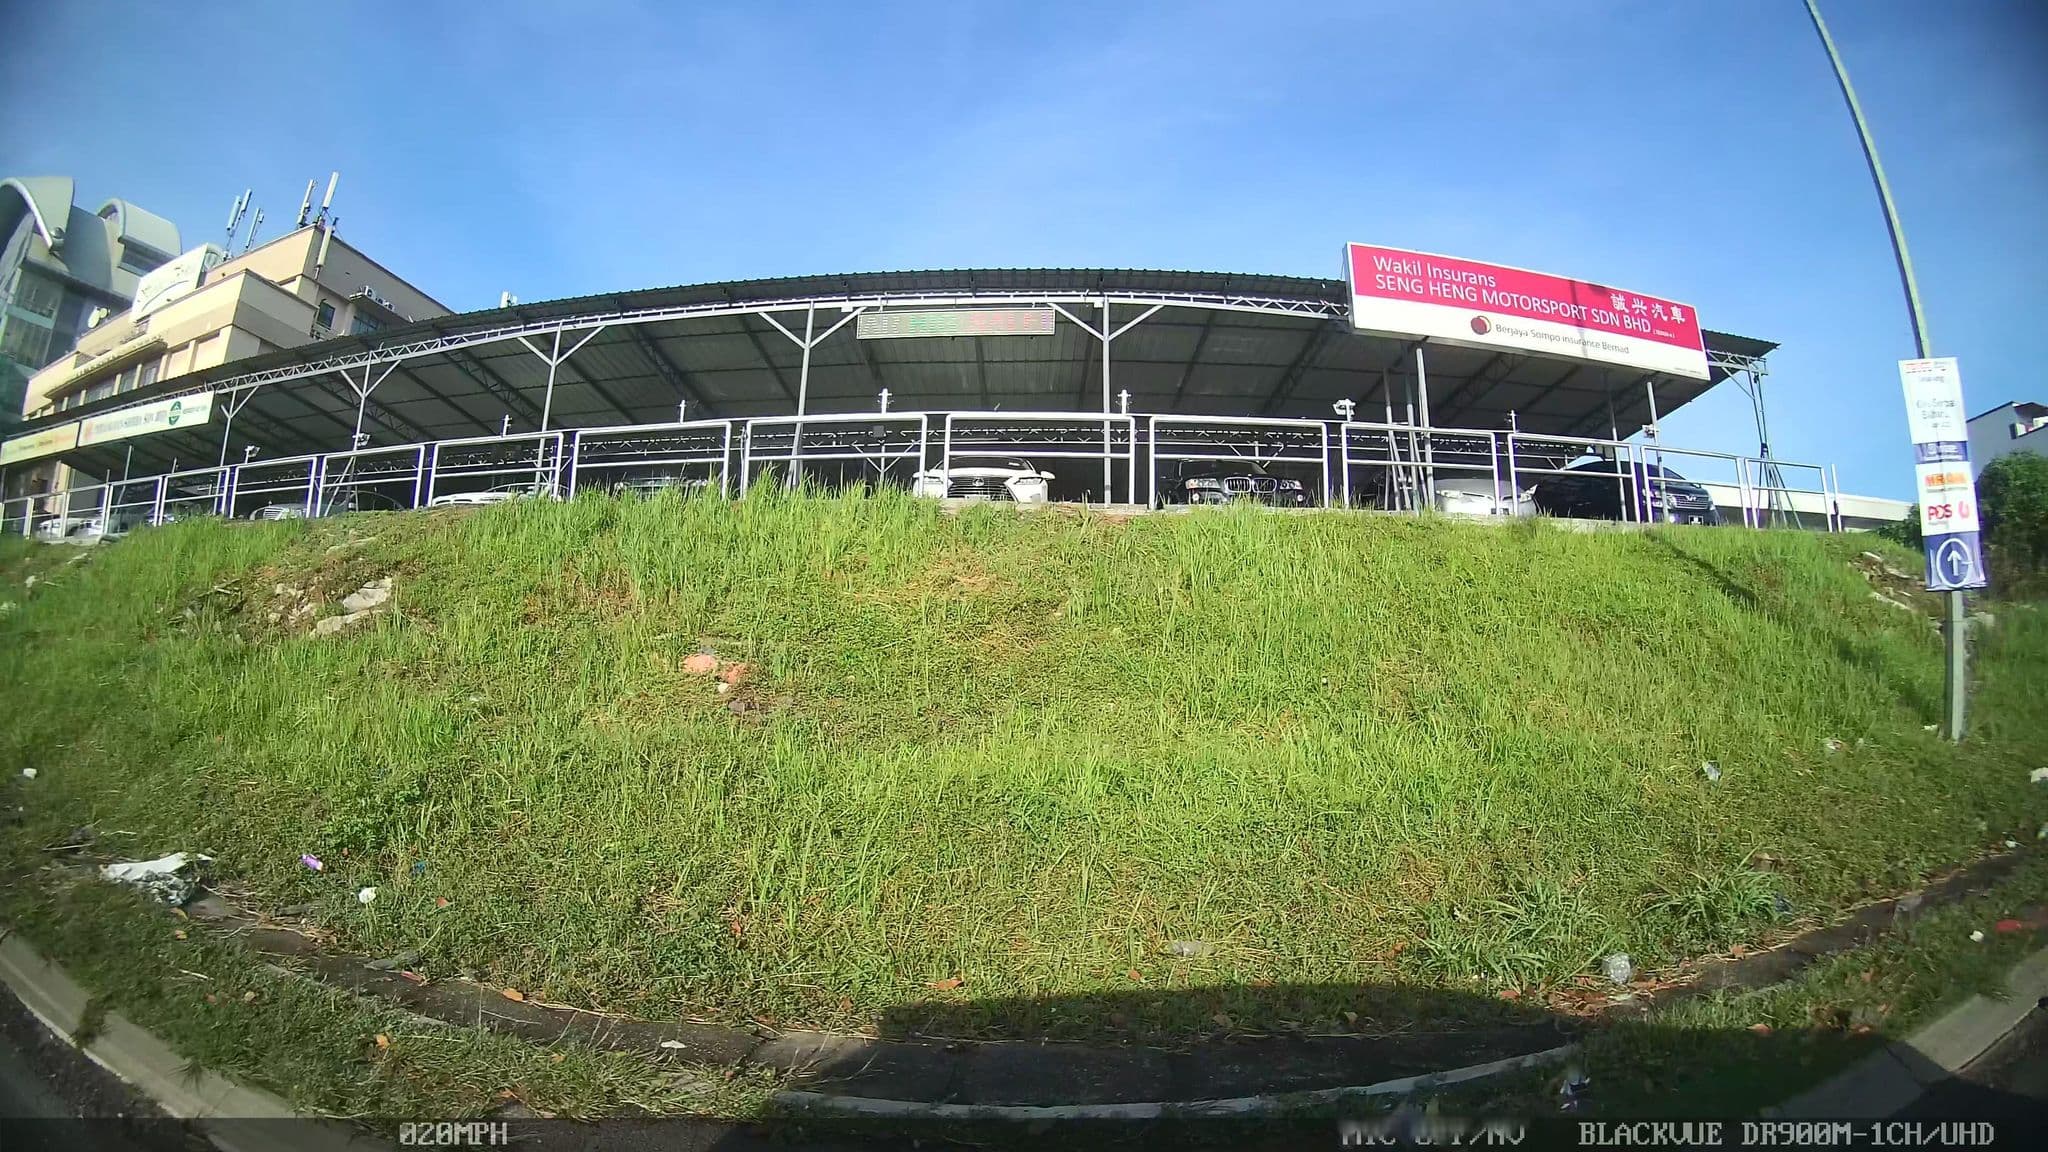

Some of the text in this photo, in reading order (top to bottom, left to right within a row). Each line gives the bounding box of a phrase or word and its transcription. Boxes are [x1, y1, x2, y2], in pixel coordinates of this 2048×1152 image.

[1373, 255, 1496, 287] Wakil Insurans
[1375, 274, 1651, 333] SENG HENG MOTORSPORT SDN BHD
[1495, 324, 1529, 338] Berjaya
[1530, 329, 1561, 343] Sompo
[1928, 503, 1952, 520] POS
